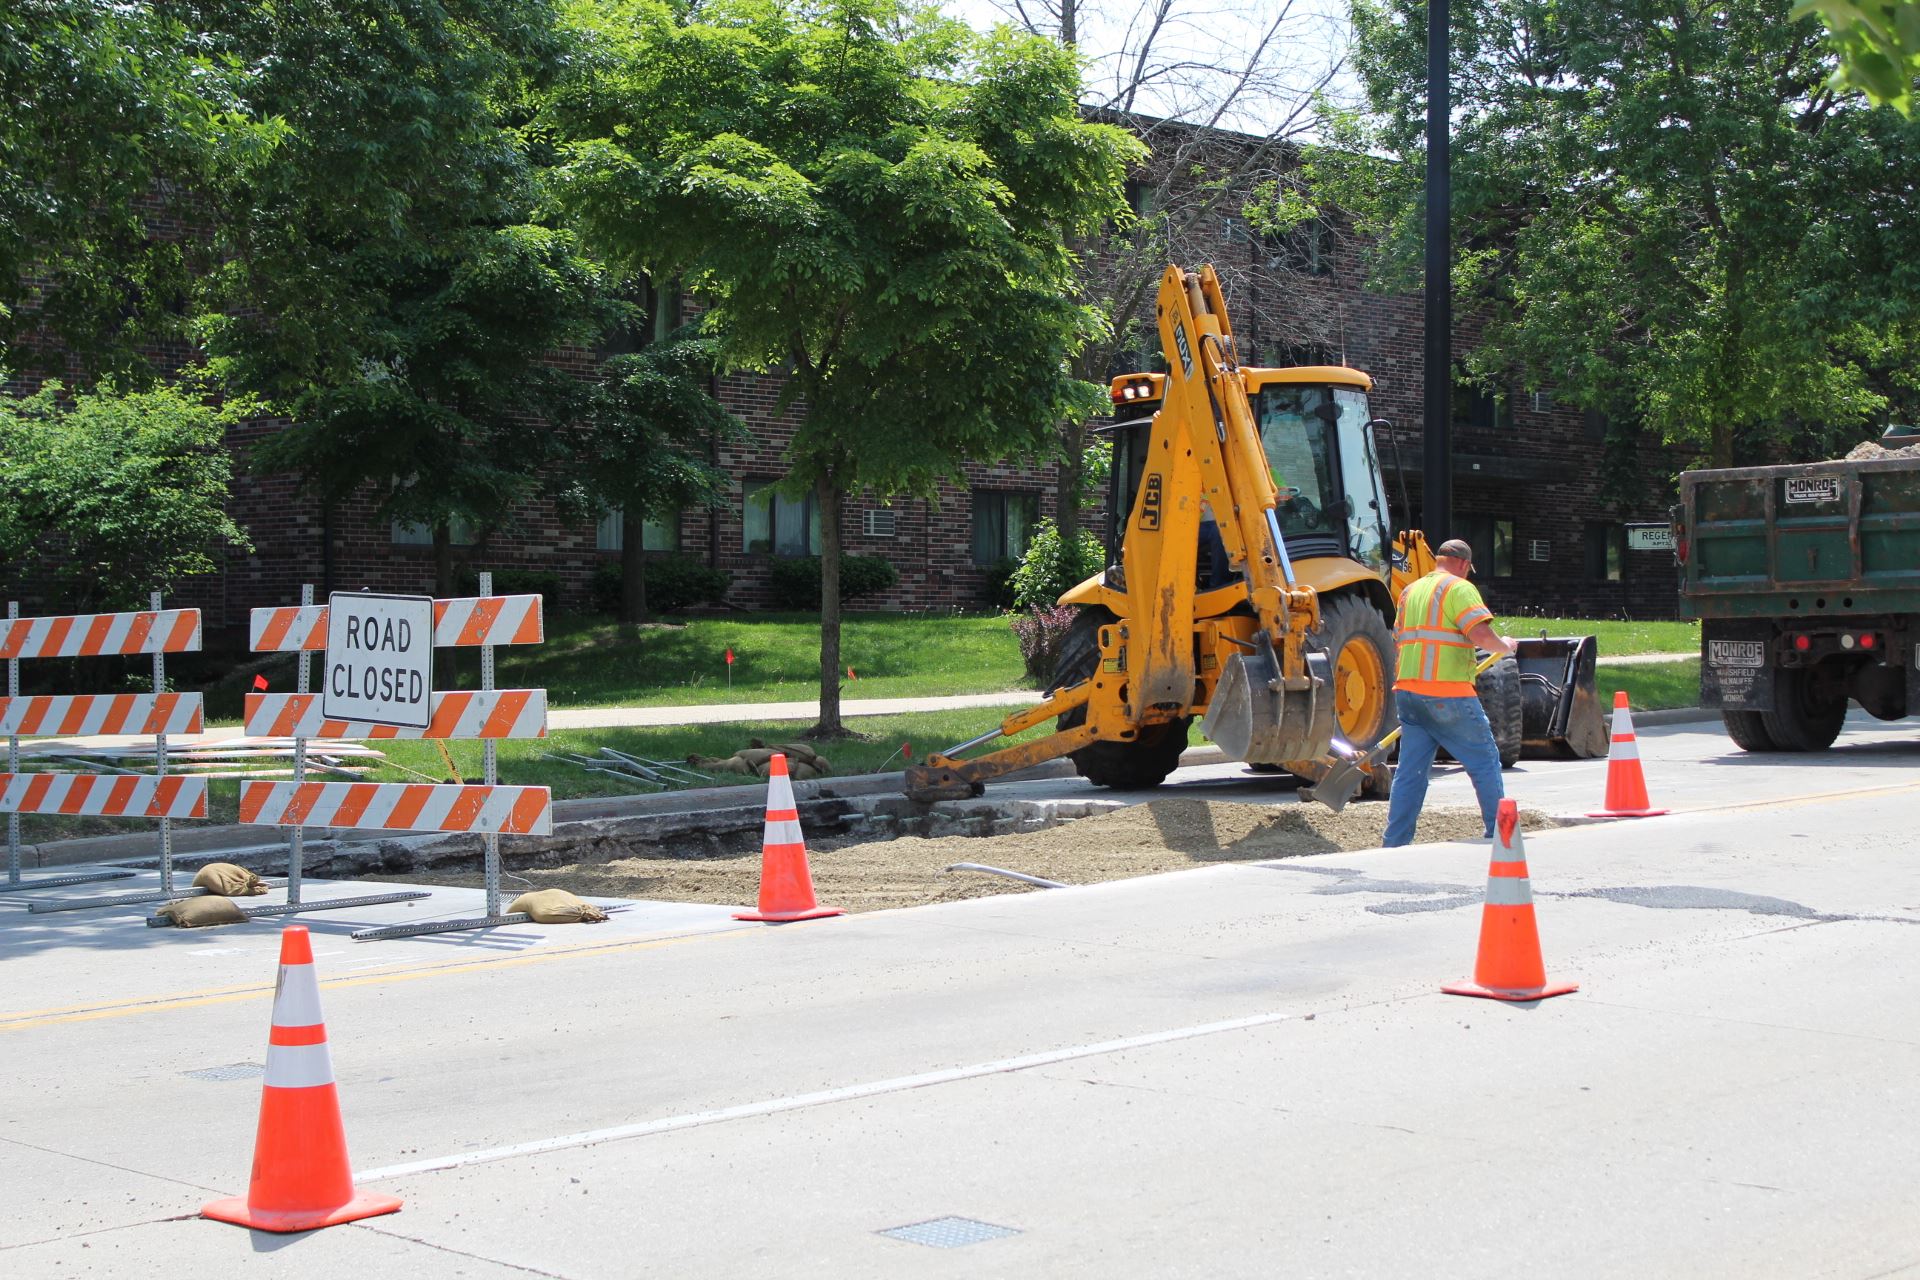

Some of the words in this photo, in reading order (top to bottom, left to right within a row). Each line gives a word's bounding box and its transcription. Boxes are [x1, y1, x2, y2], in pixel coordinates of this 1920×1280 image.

[1142, 477, 1160, 526] JCB
[1788, 478, 1838, 492] MONROE
[346, 615, 411, 653] ROAD
[1711, 642, 1762, 658] MONROE
[332, 663, 423, 704] CLOSED
